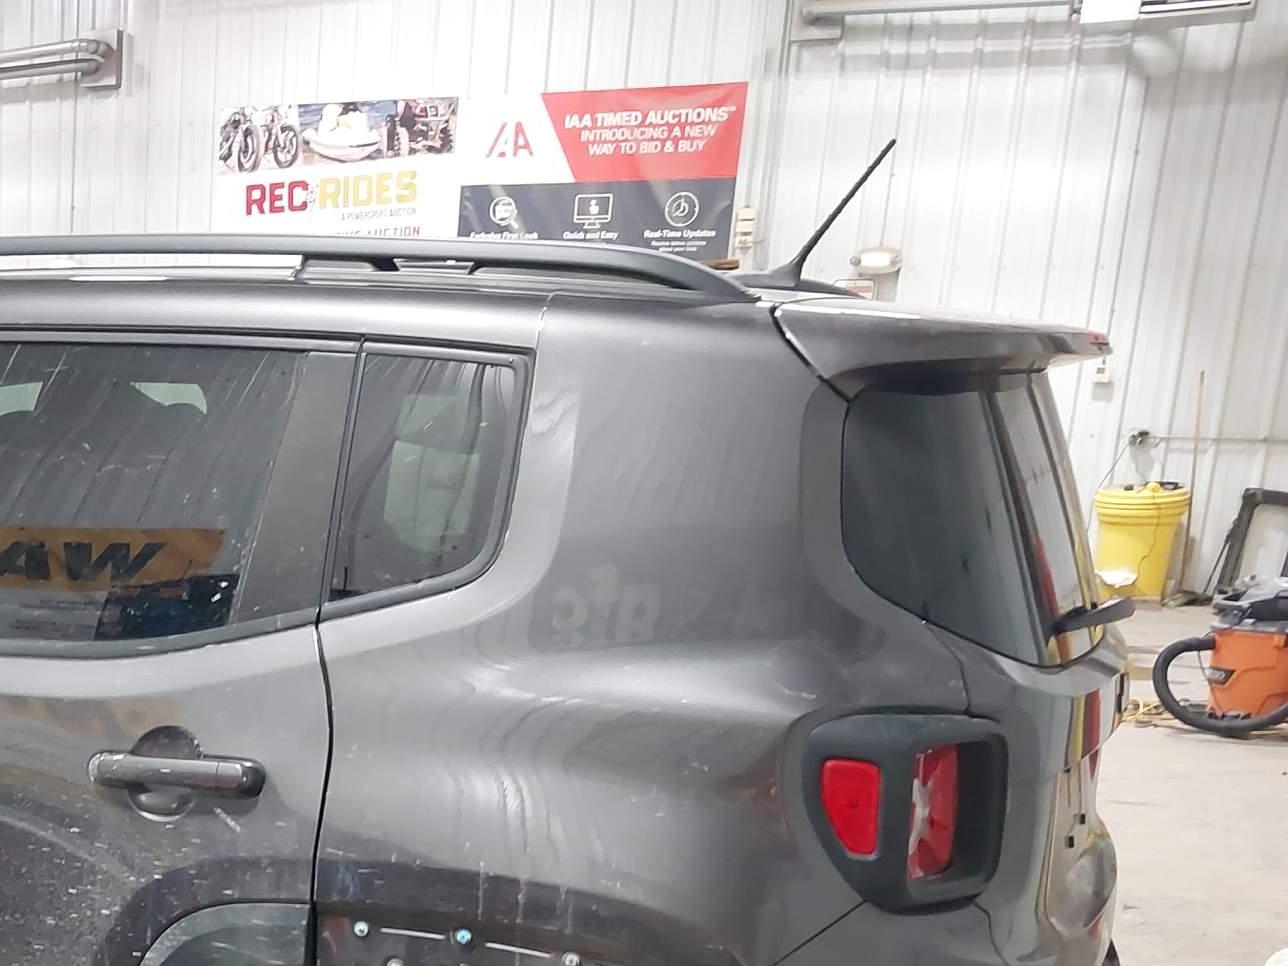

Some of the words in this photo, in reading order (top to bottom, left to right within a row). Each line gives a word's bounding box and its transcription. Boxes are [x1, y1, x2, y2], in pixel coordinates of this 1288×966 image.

[565, 112, 592, 129] IAA
[594, 110, 643, 127] TIMED
[580, 126, 668, 142] INTRODUCING
[671, 127, 682, 138] A
[684, 124, 718, 138] NEW
[588, 143, 618, 156] WAY
[619, 142, 636, 155] TO
[639, 141, 662, 154] BID
[664, 141, 675, 153] &
[677, 139, 707, 153] BUY
[246, 180, 309, 216] REC
[318, 170, 418, 209] RIDES
[563, 230, 584, 240] Quick
[585, 231, 600, 239] and
[601, 230, 619, 241] Easy
[643, 229, 682, 239] Real-Time
[683, 229, 716, 239] Updates
